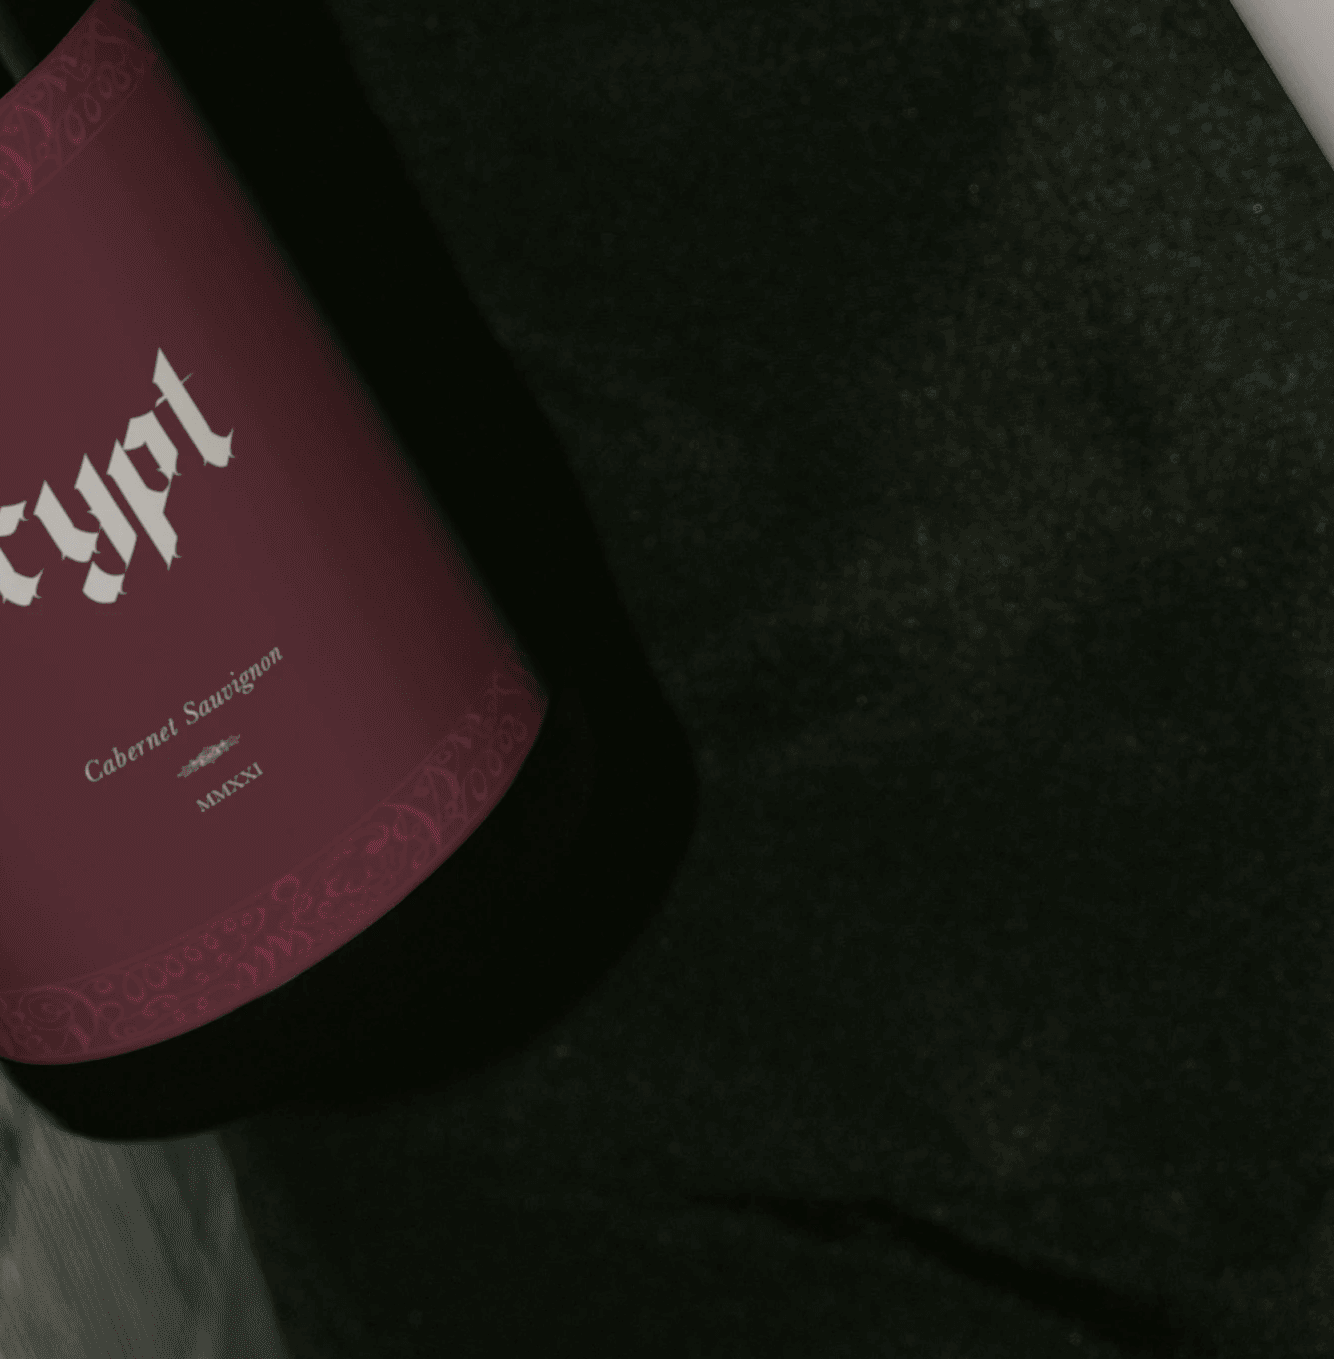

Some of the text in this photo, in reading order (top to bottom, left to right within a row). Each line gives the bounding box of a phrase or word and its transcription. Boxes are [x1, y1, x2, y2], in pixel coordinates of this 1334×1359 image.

[84, 646, 284, 783] Cabernet Sauvignon
[195, 761, 264, 813] MMXXI
